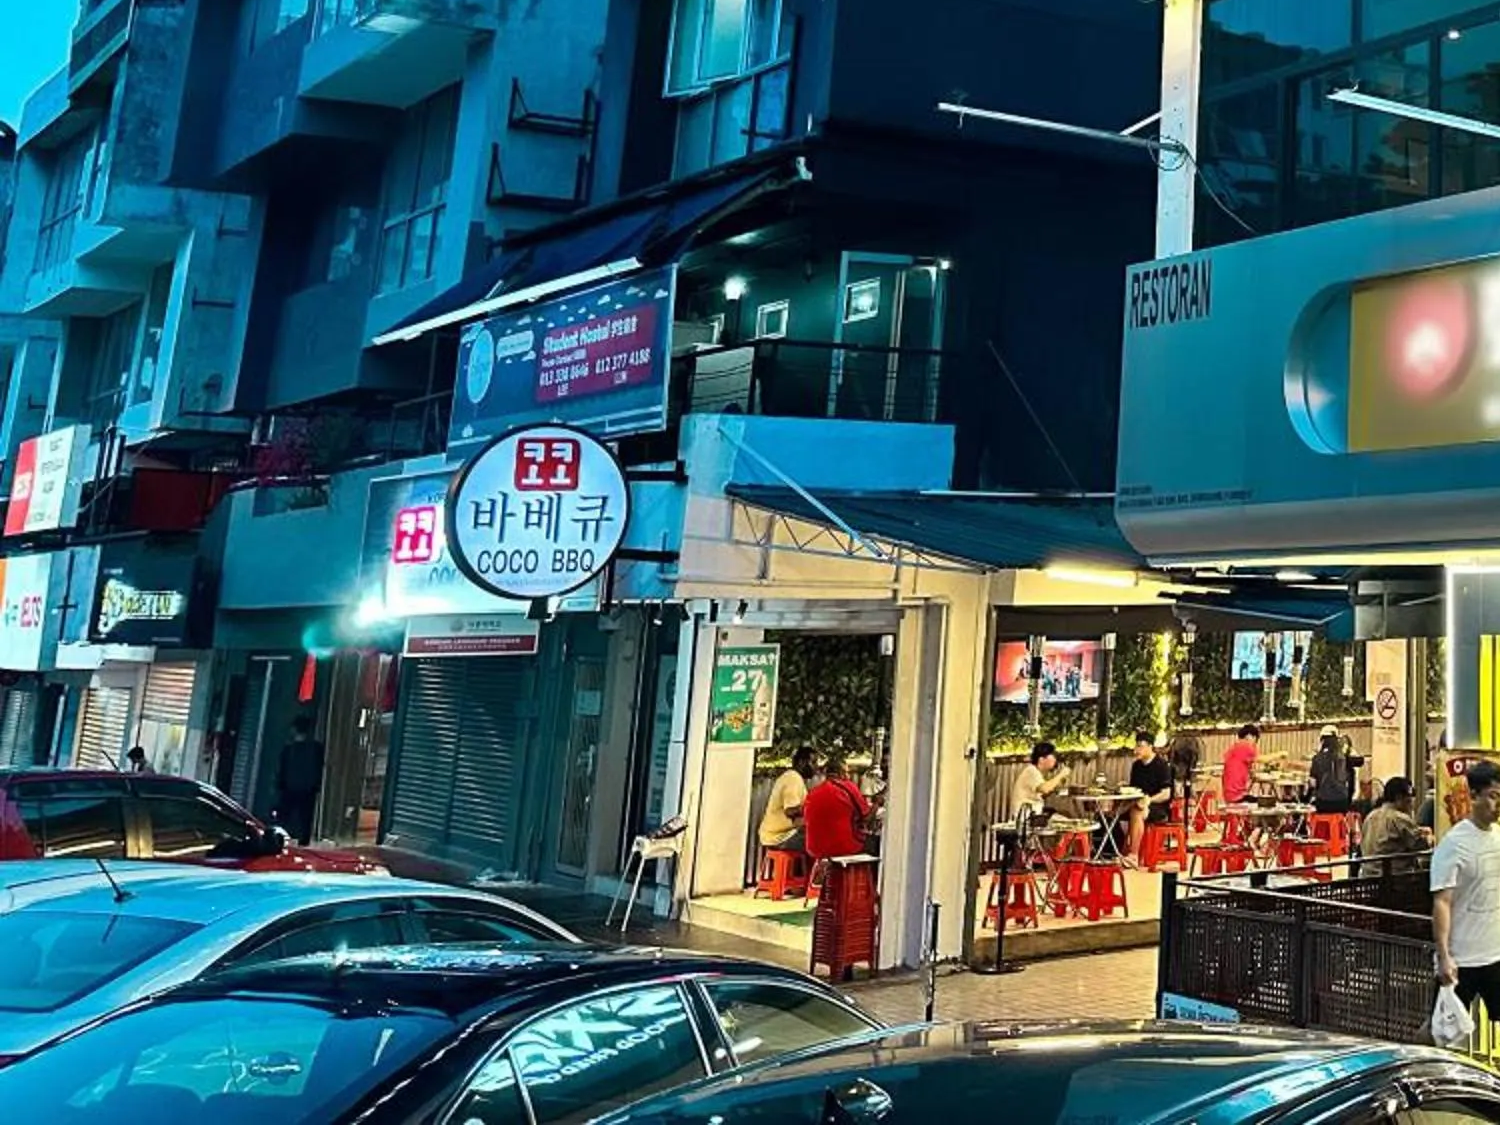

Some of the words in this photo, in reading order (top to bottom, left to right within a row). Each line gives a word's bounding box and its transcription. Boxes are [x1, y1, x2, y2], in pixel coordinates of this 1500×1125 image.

[1130, 259, 1213, 329] RESTORAN
[543, 330, 578, 355] Student
[580, 319, 611, 345] Hostel
[521, 441, 574, 485] 코코
[470, 491, 615, 544] 바베큐
[477, 548, 540, 575] COCO
[551, 548, 596, 573] BBQ
